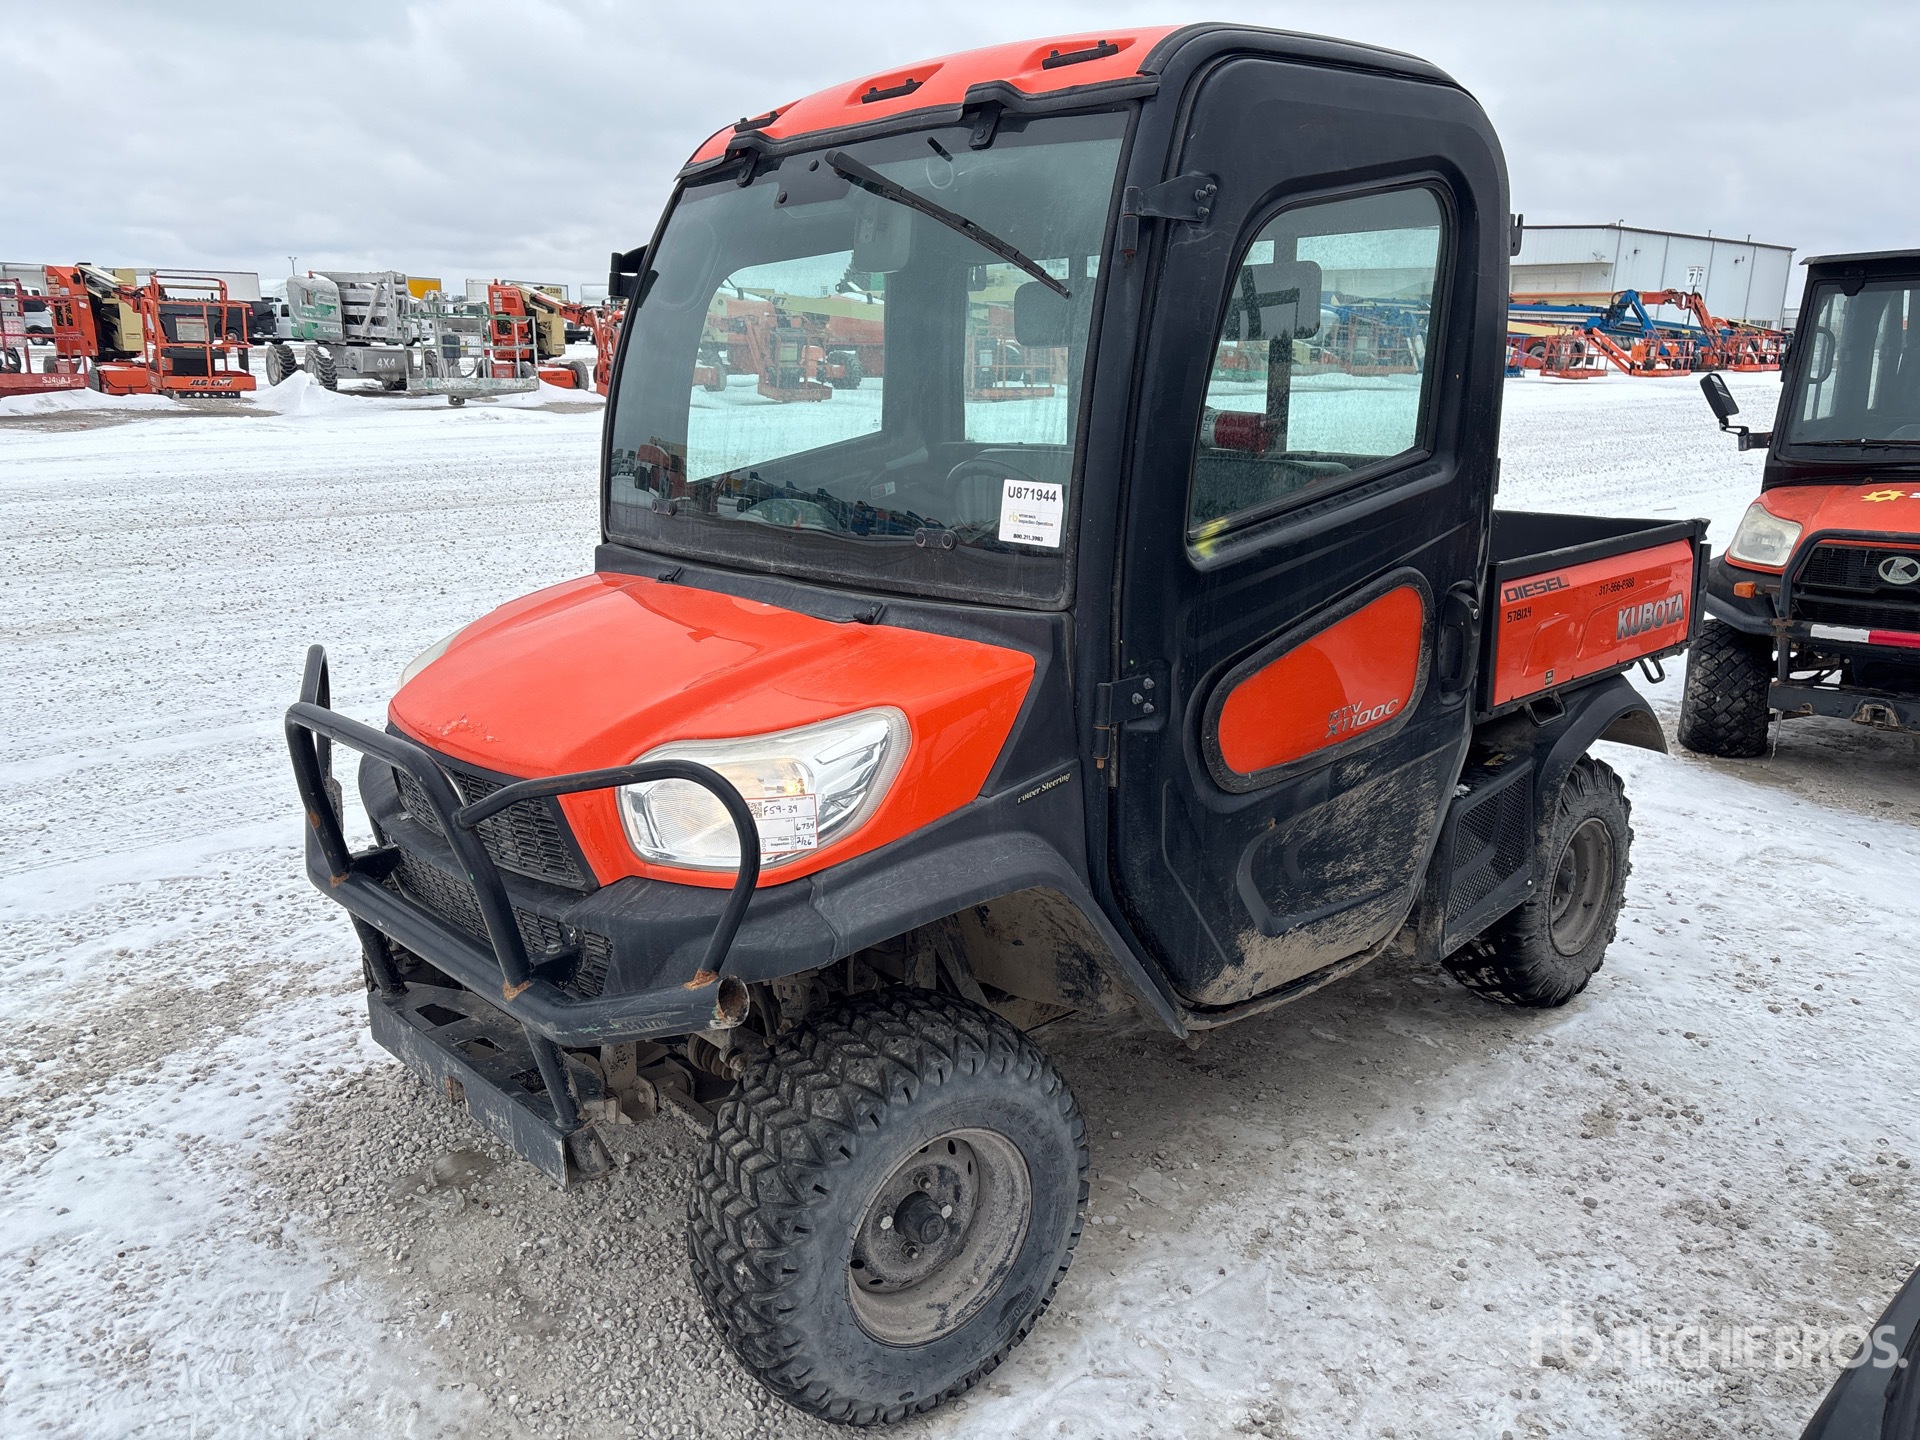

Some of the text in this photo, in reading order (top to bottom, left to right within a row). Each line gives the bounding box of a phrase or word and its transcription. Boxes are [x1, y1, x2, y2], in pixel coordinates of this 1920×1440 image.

[1689, 273, 1694, 282] 7
[376, 357, 396, 369] 4X4
[189, 379, 208, 387] JLG
[1008, 486, 1057, 502] U871944
[1504, 576, 1570, 603] DIESEL
[1616, 591, 1685, 640] KUBOTA
[1324, 698, 1400, 739] X1100C
[1328, 700, 1363, 723] RTV
[1041, 772, 1071, 792] Steering
[763, 804, 798, 816] F59-39
[796, 836, 812, 846] 2/26
